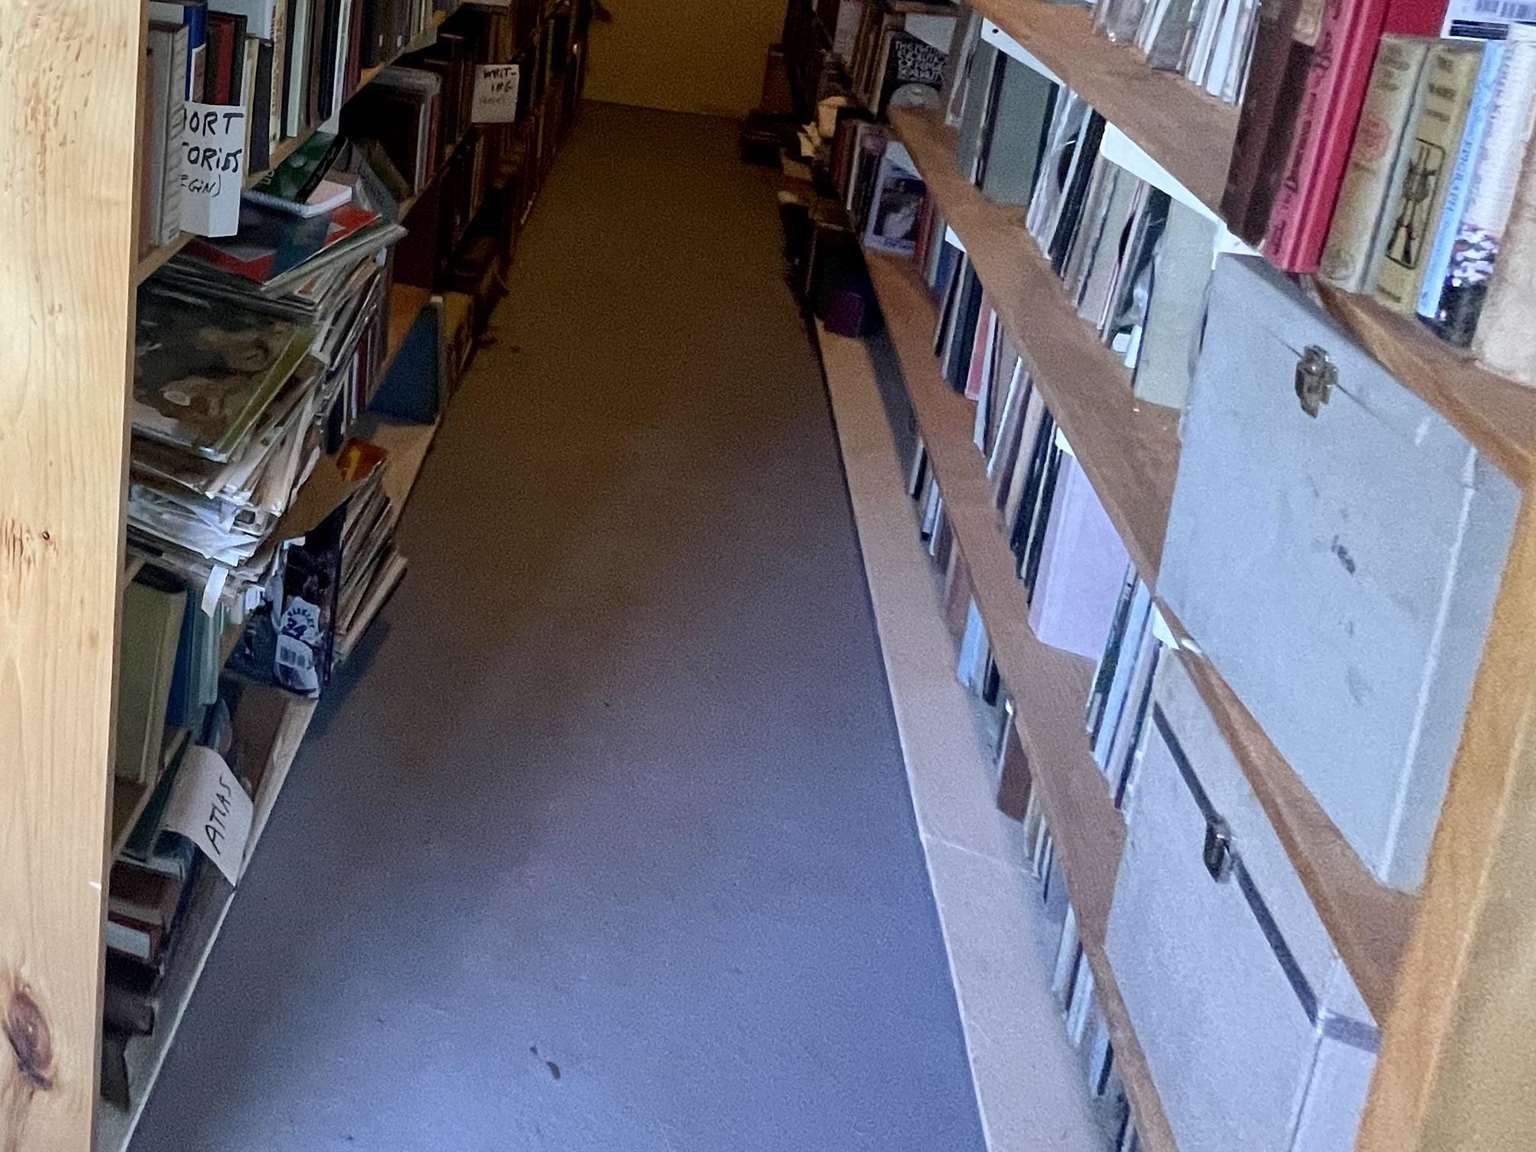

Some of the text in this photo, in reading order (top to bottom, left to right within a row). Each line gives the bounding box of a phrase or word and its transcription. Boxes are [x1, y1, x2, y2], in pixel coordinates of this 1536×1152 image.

[184, 108, 244, 136] ORT
[182, 142, 242, 173] ORIES
[205, 775, 231, 857] ATLAS
